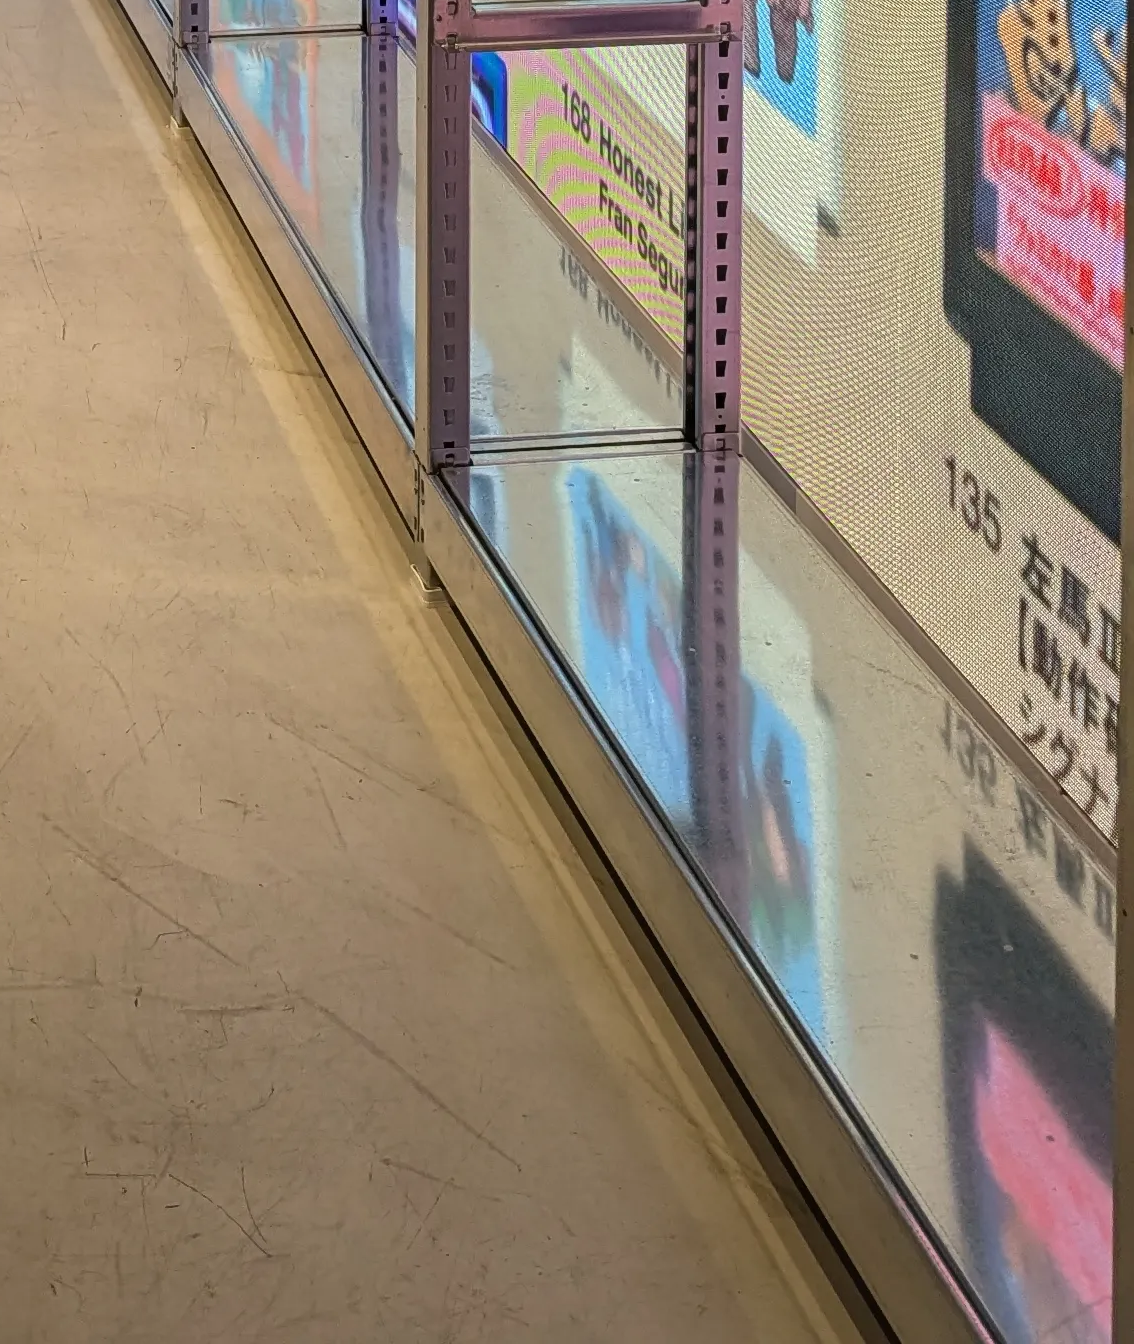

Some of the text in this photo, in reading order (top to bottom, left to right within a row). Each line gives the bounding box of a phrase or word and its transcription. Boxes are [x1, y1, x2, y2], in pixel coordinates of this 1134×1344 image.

[561, 83, 591, 143] 168
[599, 119, 662, 220] Honest
[599, 179, 633, 245] Fran
[943, 454, 1003, 554] 135
